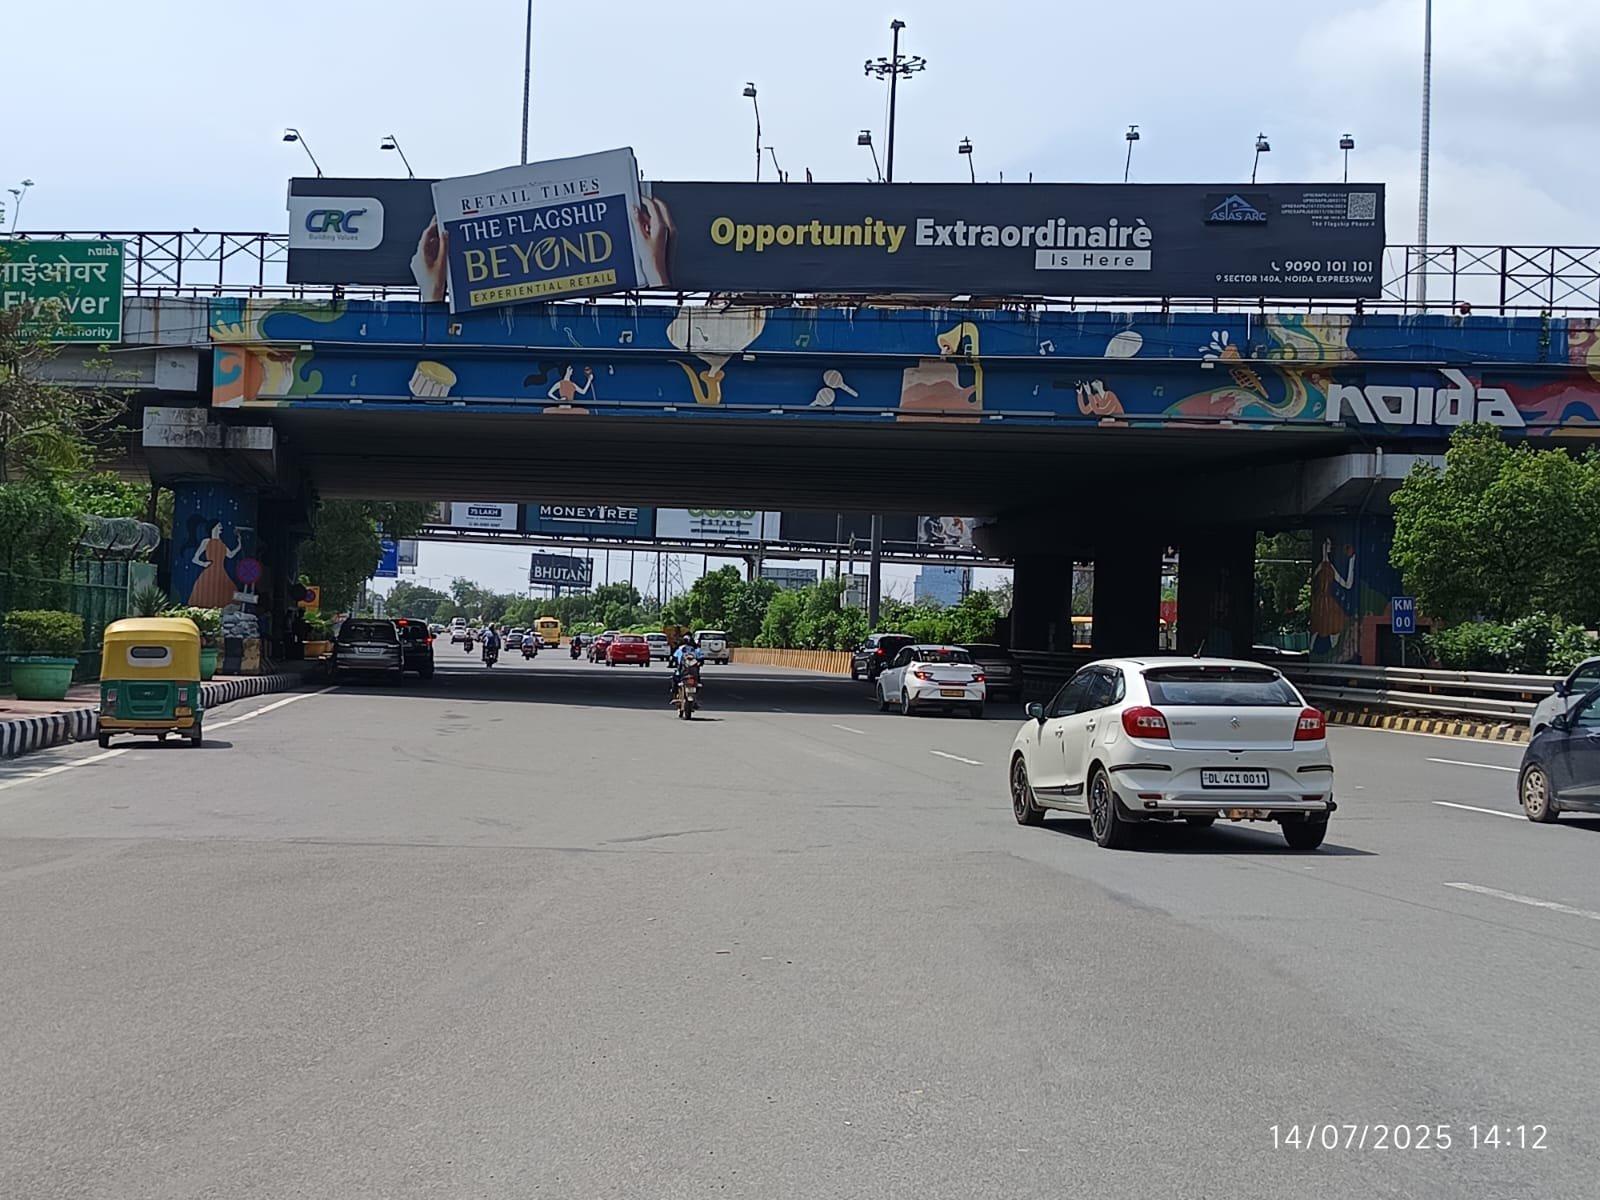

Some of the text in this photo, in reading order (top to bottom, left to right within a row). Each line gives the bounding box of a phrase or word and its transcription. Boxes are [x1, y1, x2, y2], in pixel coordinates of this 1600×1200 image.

[461, 190, 530, 210] RETAIL
[541, 178, 600, 198] TIMES
[305, 209, 365, 234] CRC
[460, 202, 607, 242] THE FLAGSHIP
[710, 216, 1152, 253] Opportunity Extraordinairè
[88, 244, 120, 256] noida
[464, 231, 613, 283] BEYOND
[1051, 253, 1135, 266] Is Here
[1285, 261, 1373, 272] 9090 101 101
[1223, 274, 1258, 282] SECTOR
[1285, 275, 1314, 283] NOIDA
[1316, 275, 1374, 283] EXPRESSWAY
[473, 274, 613, 302] EXPERIENTIAL RETAIL
[1325, 368, 1526, 427] noida
[479, 508, 498, 516] LAKH
[540, 505, 638, 520] MONEYTREE
[534, 565, 591, 581] BHUTANI
[1394, 599, 1413, 611] KM
[1395, 616, 1411, 628] 00
[1208, 773, 1221, 784] DL
[1243, 773, 1267, 785] 0011
